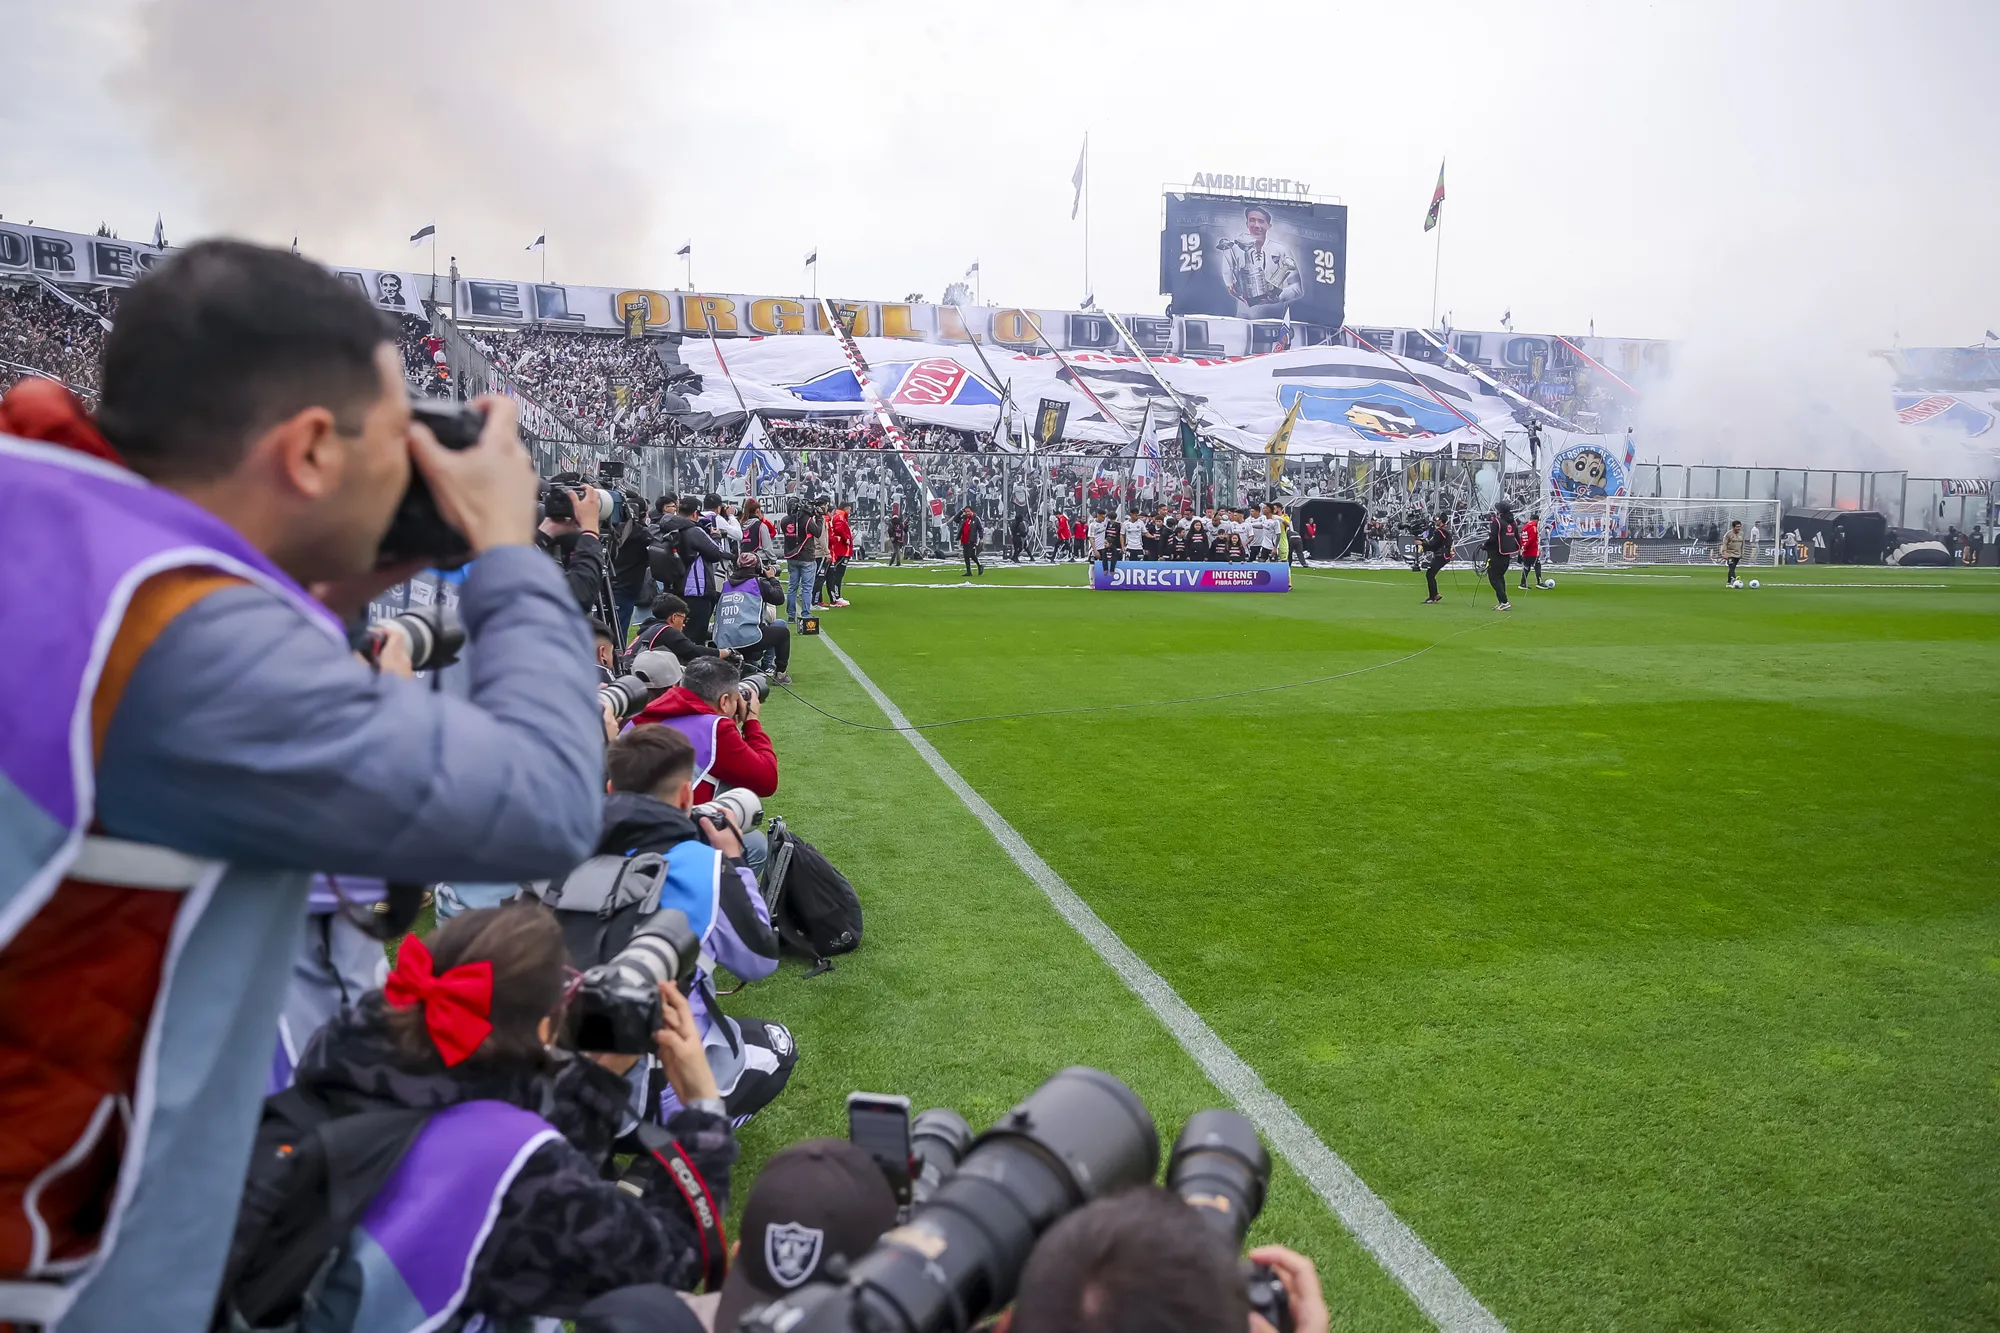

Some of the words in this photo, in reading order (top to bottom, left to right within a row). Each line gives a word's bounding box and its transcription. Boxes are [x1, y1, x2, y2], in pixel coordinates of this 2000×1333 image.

[1192, 172, 1291, 193] AMBILIGHT
[1295, 181, 1311, 195] tv
[1180, 233, 1201, 252] 19
[1180, 250, 1203, 272] 25
[1313, 249, 1335, 269] 20
[1315, 266, 1336, 284] 25
[468, 281, 586, 322] EL
[616, 290, 1044, 342] ORGULLO
[1070, 314, 1225, 354] DEL
[903, 364, 959, 403] COLO
[1110, 569, 1200, 587] DIRECTV
[1212, 570, 1258, 579] INTERNET
[720, 604, 739, 616] FOTO
[670, 1157, 701, 1197] EOS
